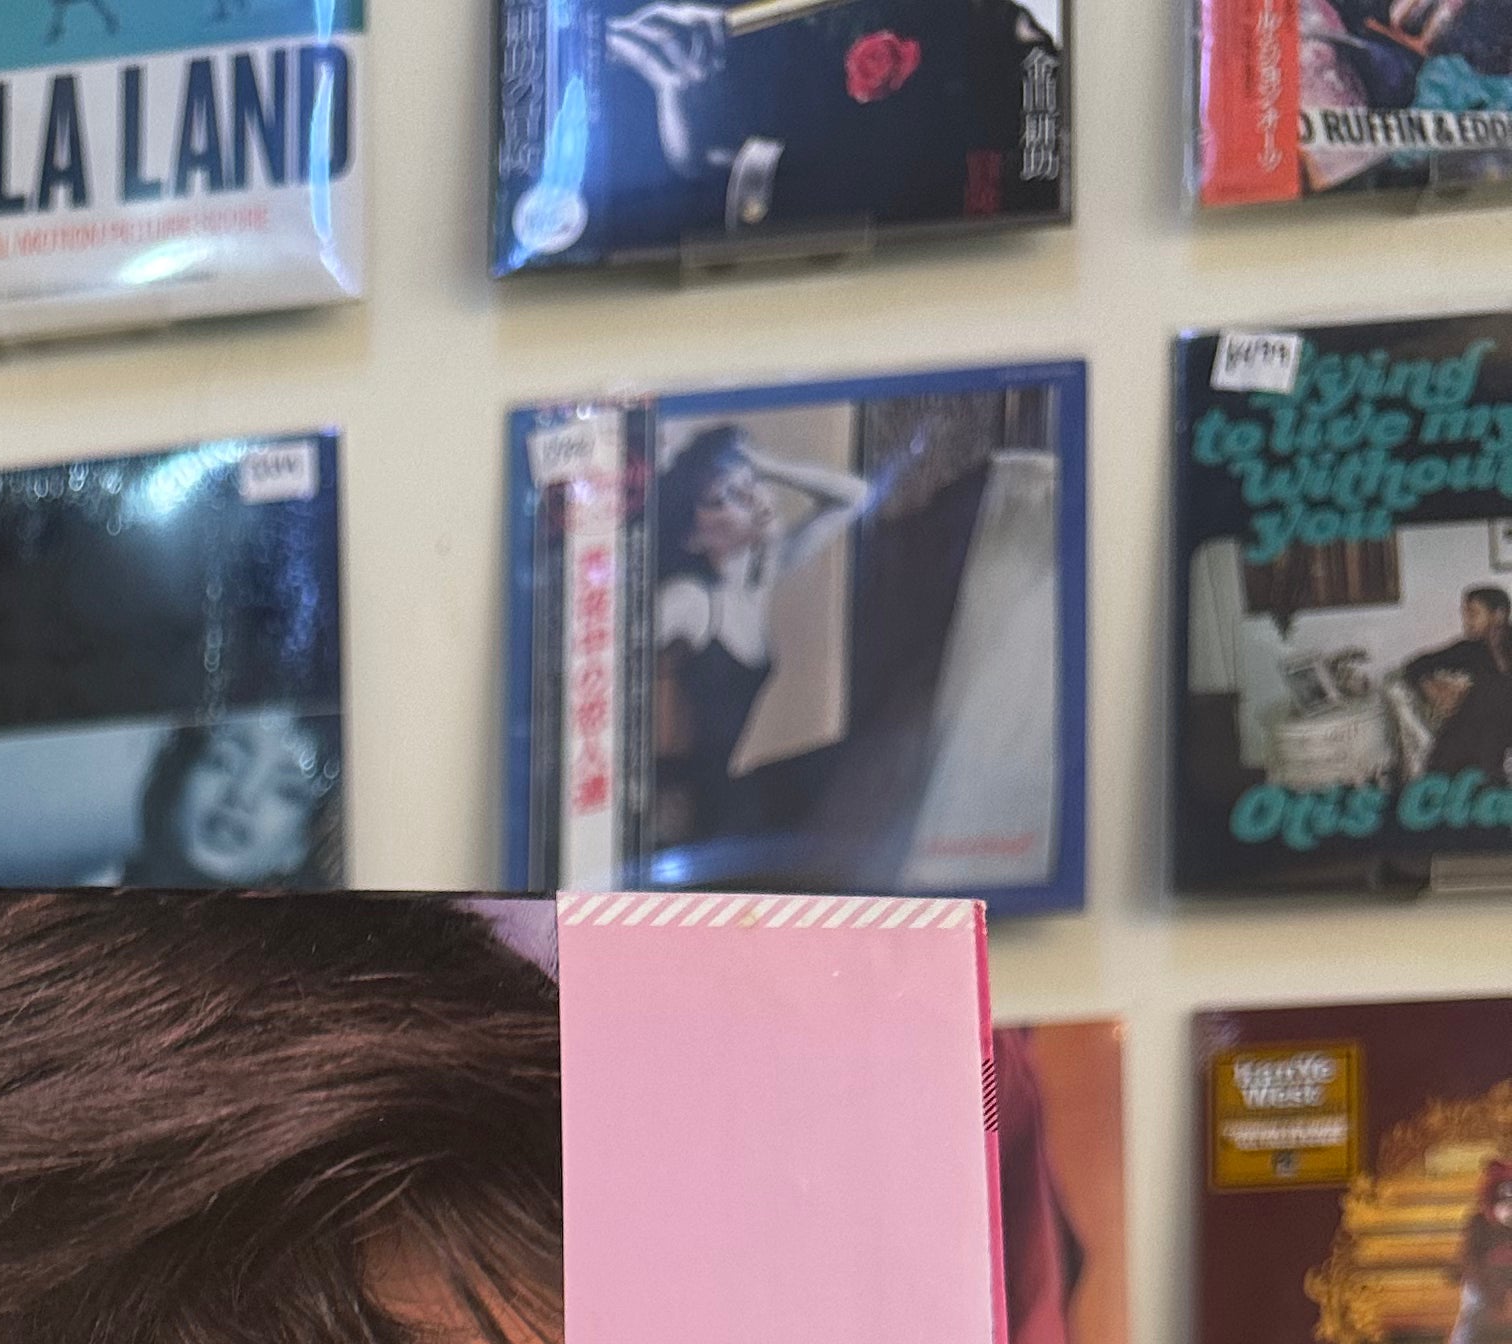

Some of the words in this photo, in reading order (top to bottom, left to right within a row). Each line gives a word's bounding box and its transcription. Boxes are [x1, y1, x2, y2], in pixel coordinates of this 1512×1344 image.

[119, 44, 356, 206] LAND
[1322, 109, 1427, 144] RUFFIN
[1433, 110, 1453, 144] &
[1245, 502, 1393, 566] you
[1397, 766, 1512, 831] Cla
